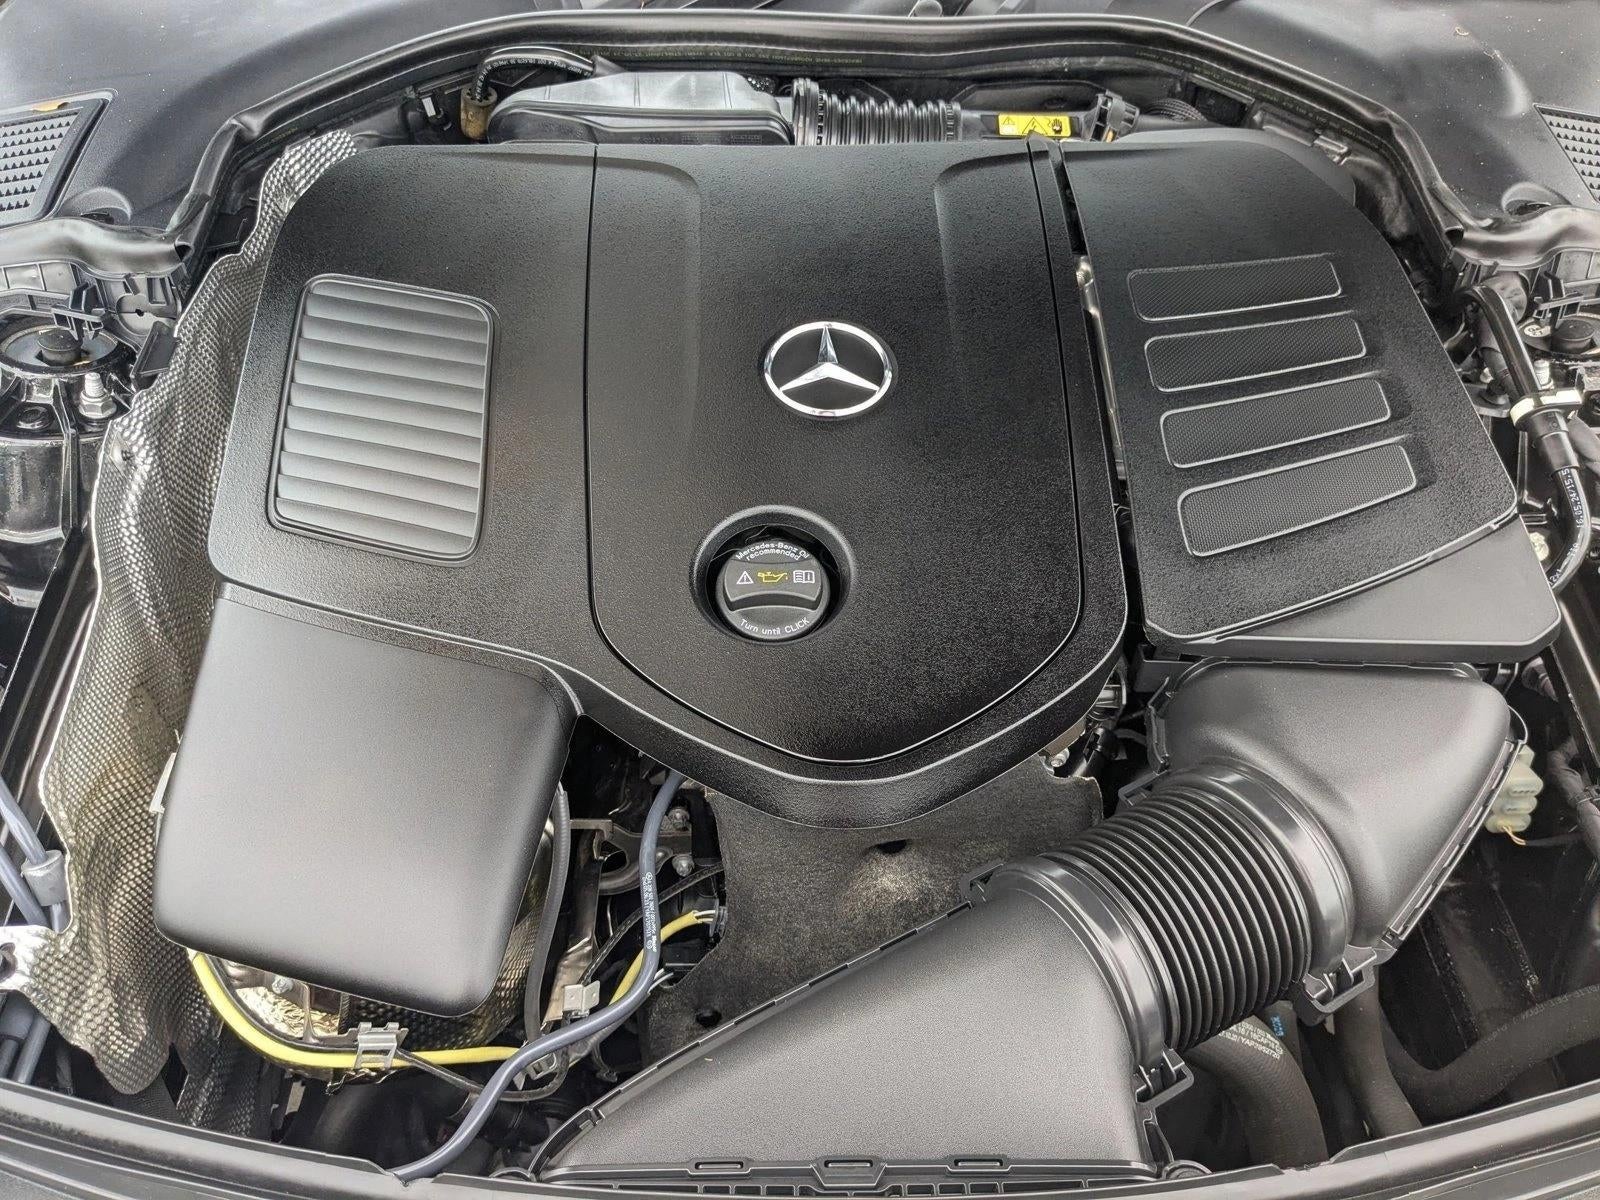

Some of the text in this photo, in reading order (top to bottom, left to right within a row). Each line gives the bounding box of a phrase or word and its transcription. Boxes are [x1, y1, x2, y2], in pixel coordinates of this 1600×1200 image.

[736, 542, 810, 560] Mercedes-Benz Oil
[746, 548, 801, 561] recommended
[740, 617, 810, 635] Turn until CLICK
